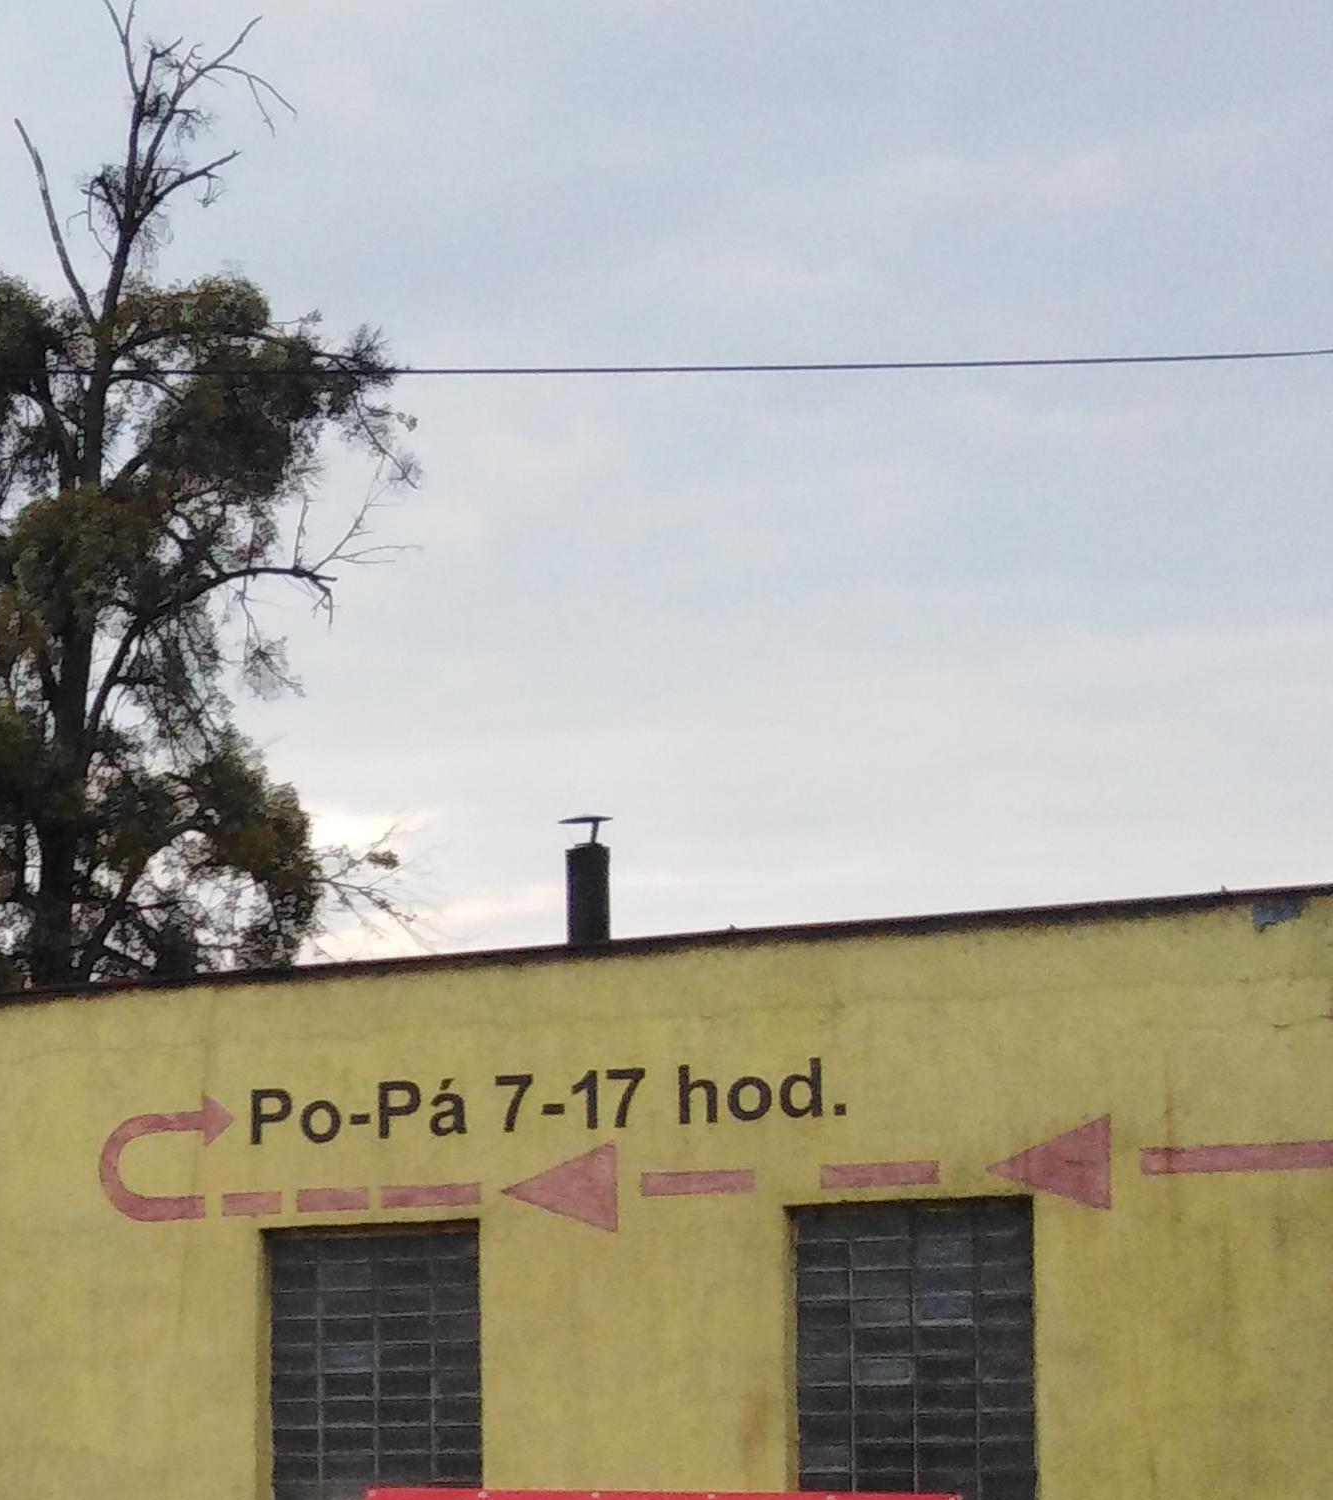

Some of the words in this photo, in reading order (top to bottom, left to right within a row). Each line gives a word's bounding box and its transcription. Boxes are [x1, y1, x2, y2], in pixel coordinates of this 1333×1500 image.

[250, 1078, 468, 1145] Po-Pá
[495, 1068, 645, 1133] 7-17
[678, 1057, 847, 1124] hod.
